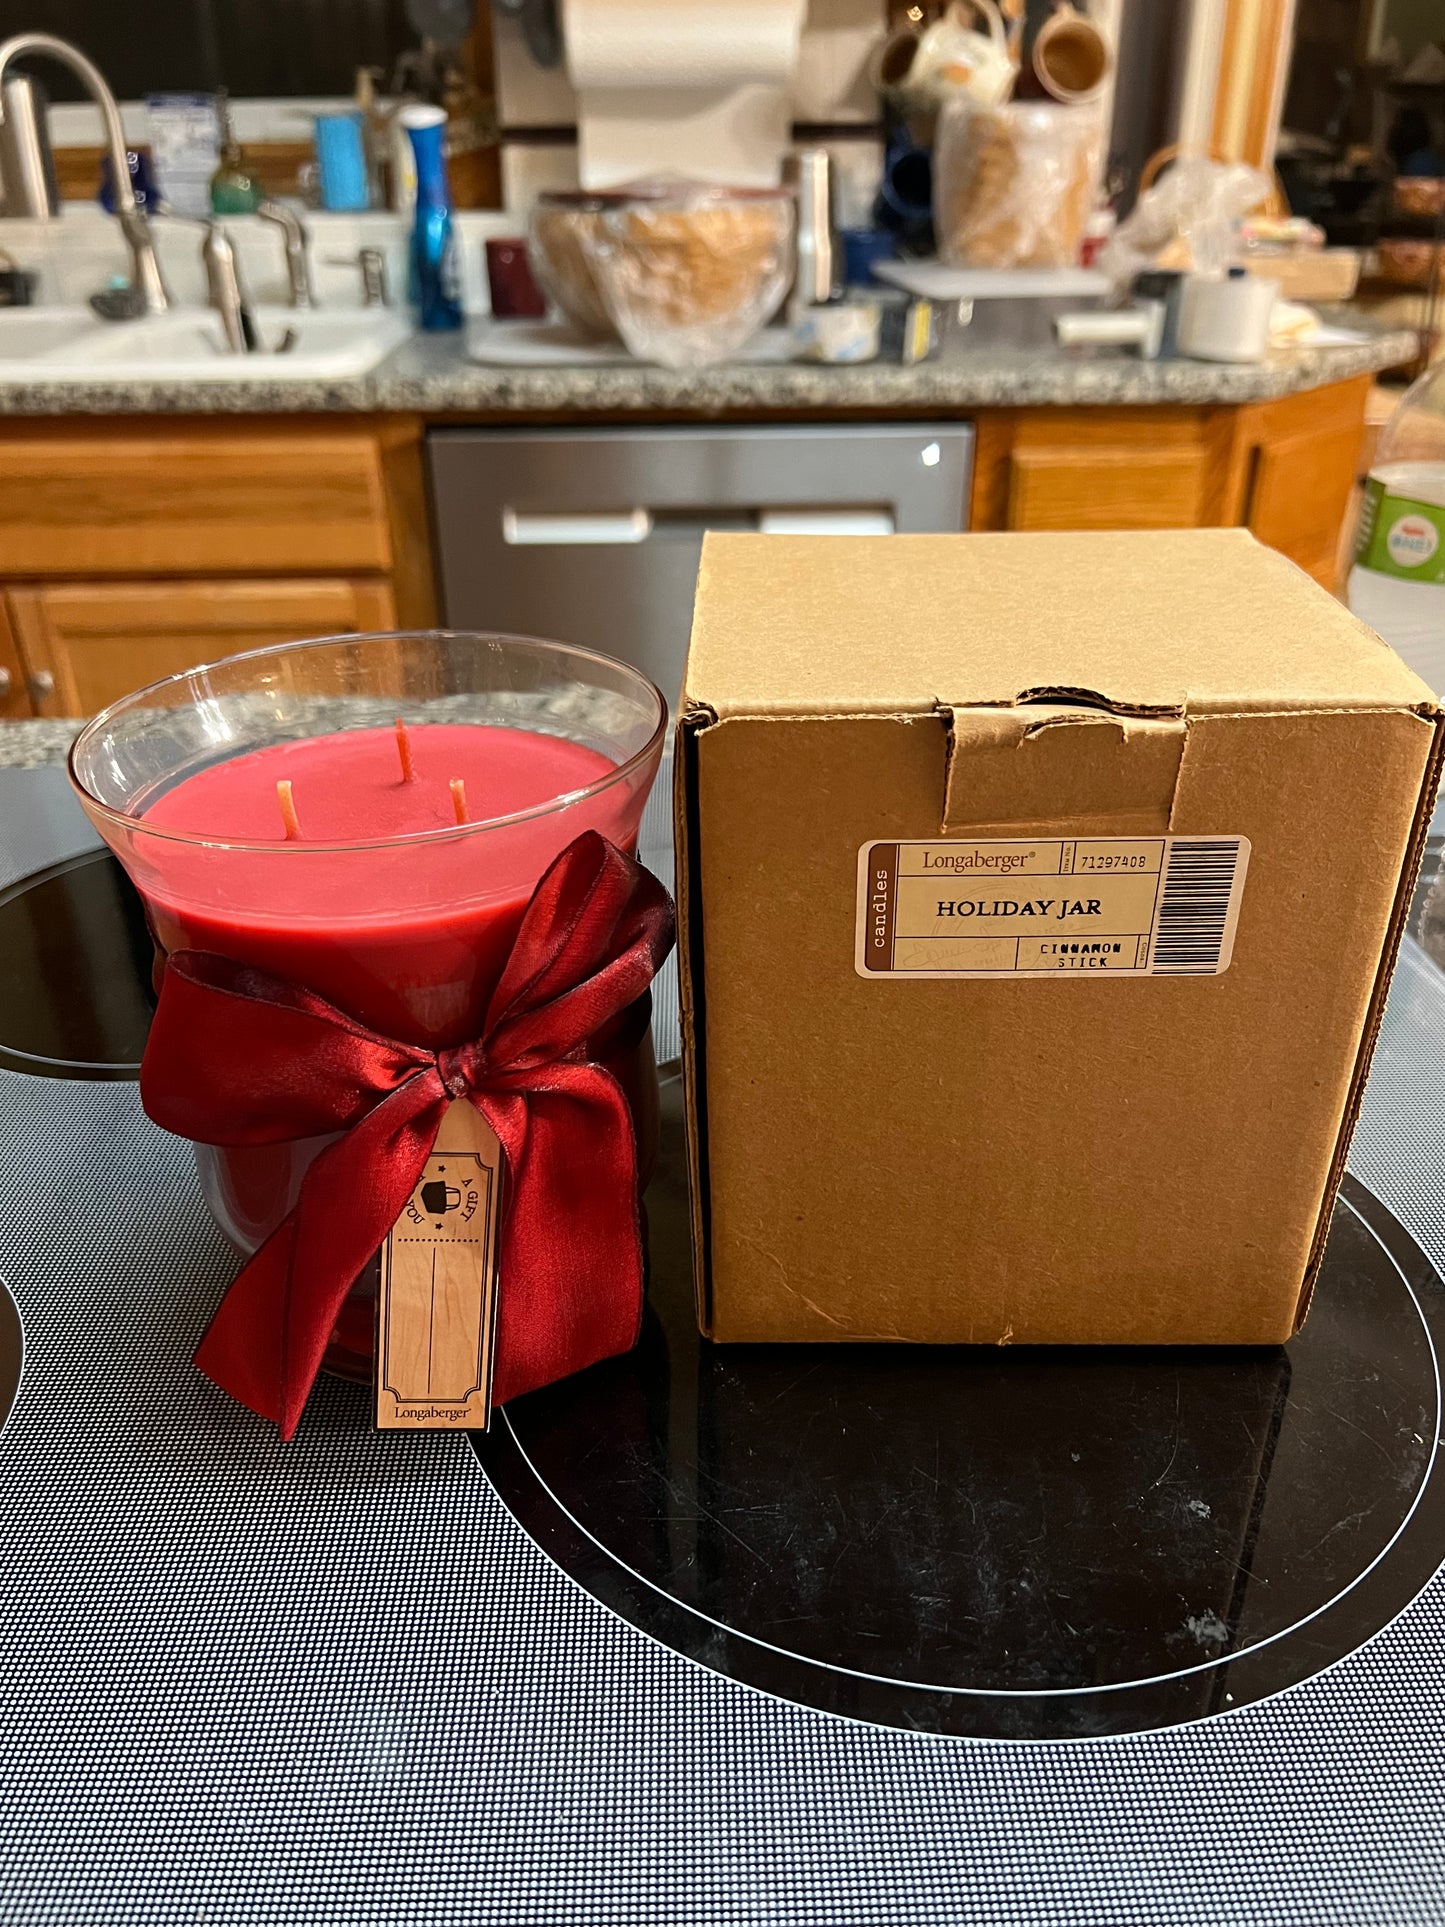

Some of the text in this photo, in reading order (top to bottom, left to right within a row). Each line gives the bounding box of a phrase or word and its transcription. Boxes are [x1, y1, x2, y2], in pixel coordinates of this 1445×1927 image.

[1081, 856, 1146, 869] 71297408
[873, 870, 888, 948] candles
[936, 899, 1102, 920] HOLIDAY JAR
[1040, 943, 1121, 954] CINNAMON
[1058, 957, 1107, 967] STICK
[460, 1178, 478, 1222] A GIFT
[406, 1199, 425, 1225] YOU
